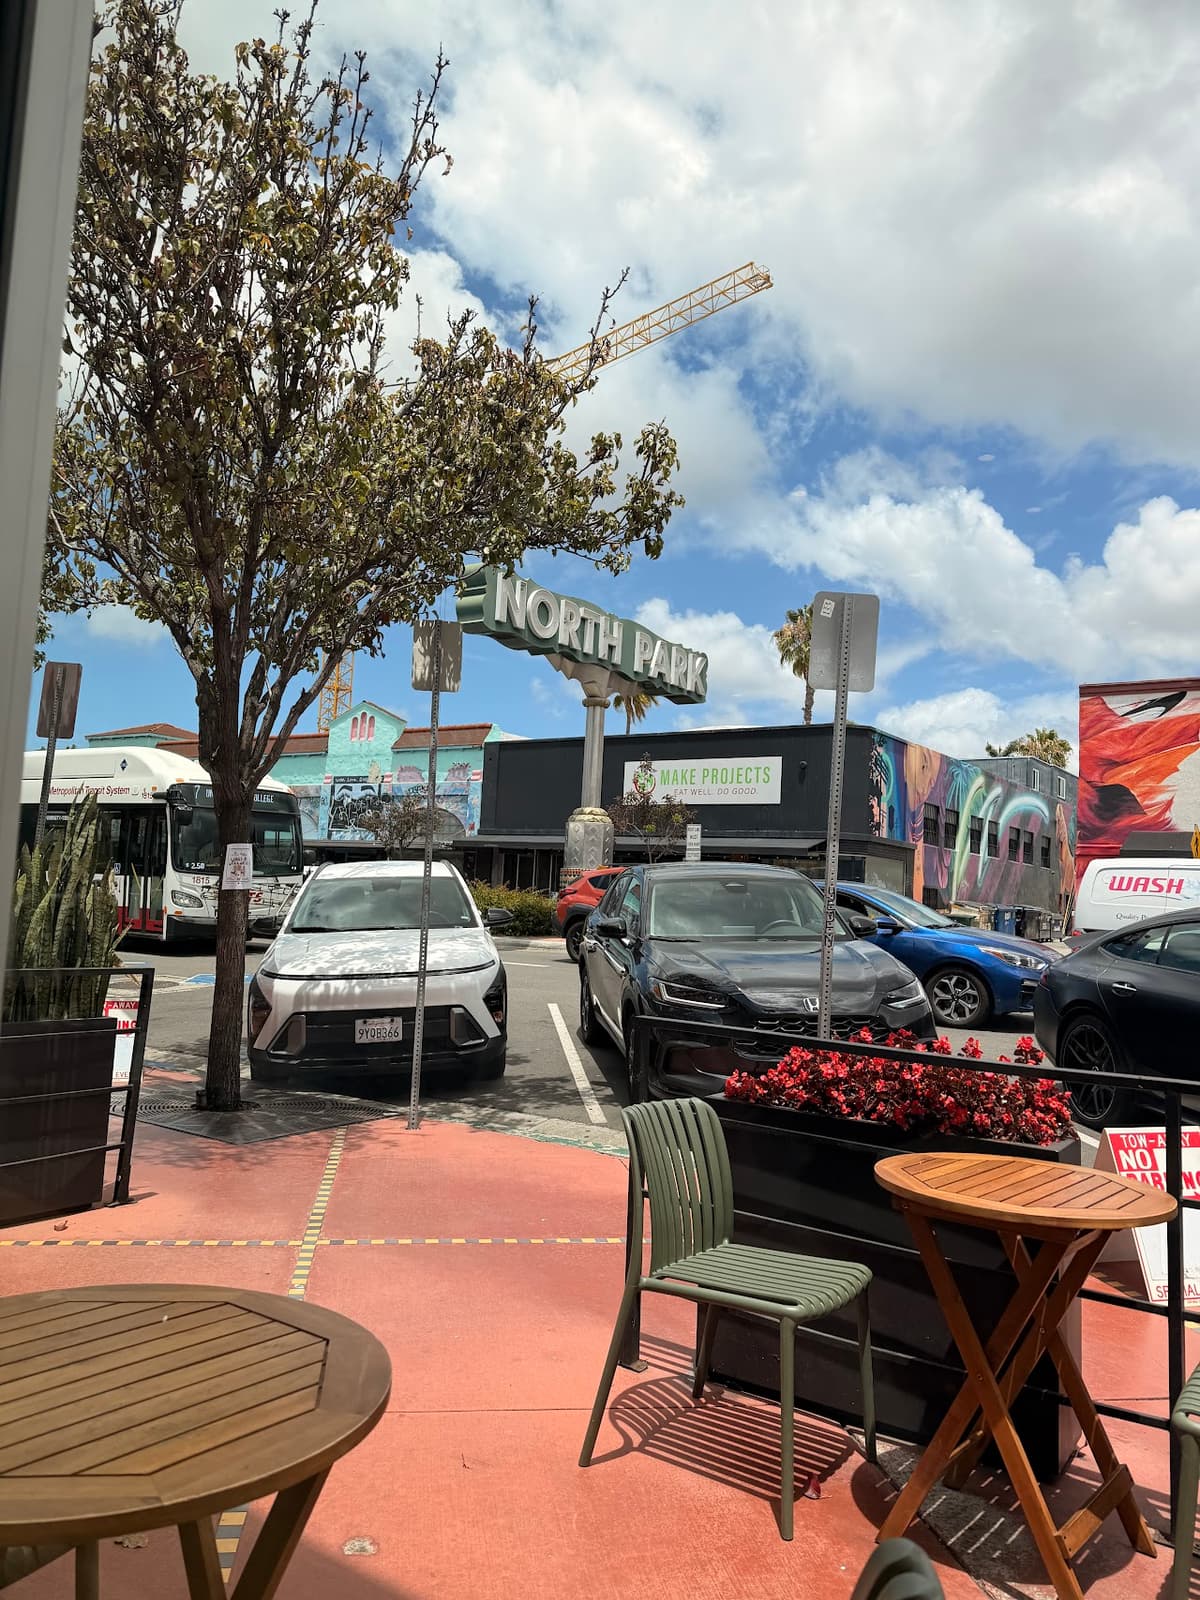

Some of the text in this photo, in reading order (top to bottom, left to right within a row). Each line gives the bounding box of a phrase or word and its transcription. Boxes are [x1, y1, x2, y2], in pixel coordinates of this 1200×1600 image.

[494, 572, 708, 696] NORTH PARK
[660, 766, 771, 785] MAKE PROJECTS
[106, 786, 130, 796] System
[194, 785, 201, 799] 7
[674, 788, 688, 797] EAT
[717, 787, 729, 795] DO
[253, 794, 275, 804] OLLEGE
[192, 876, 210, 885] 1815
[1108, 875, 1185, 895] WASH
[1119, 1148, 1153, 1170] NO
